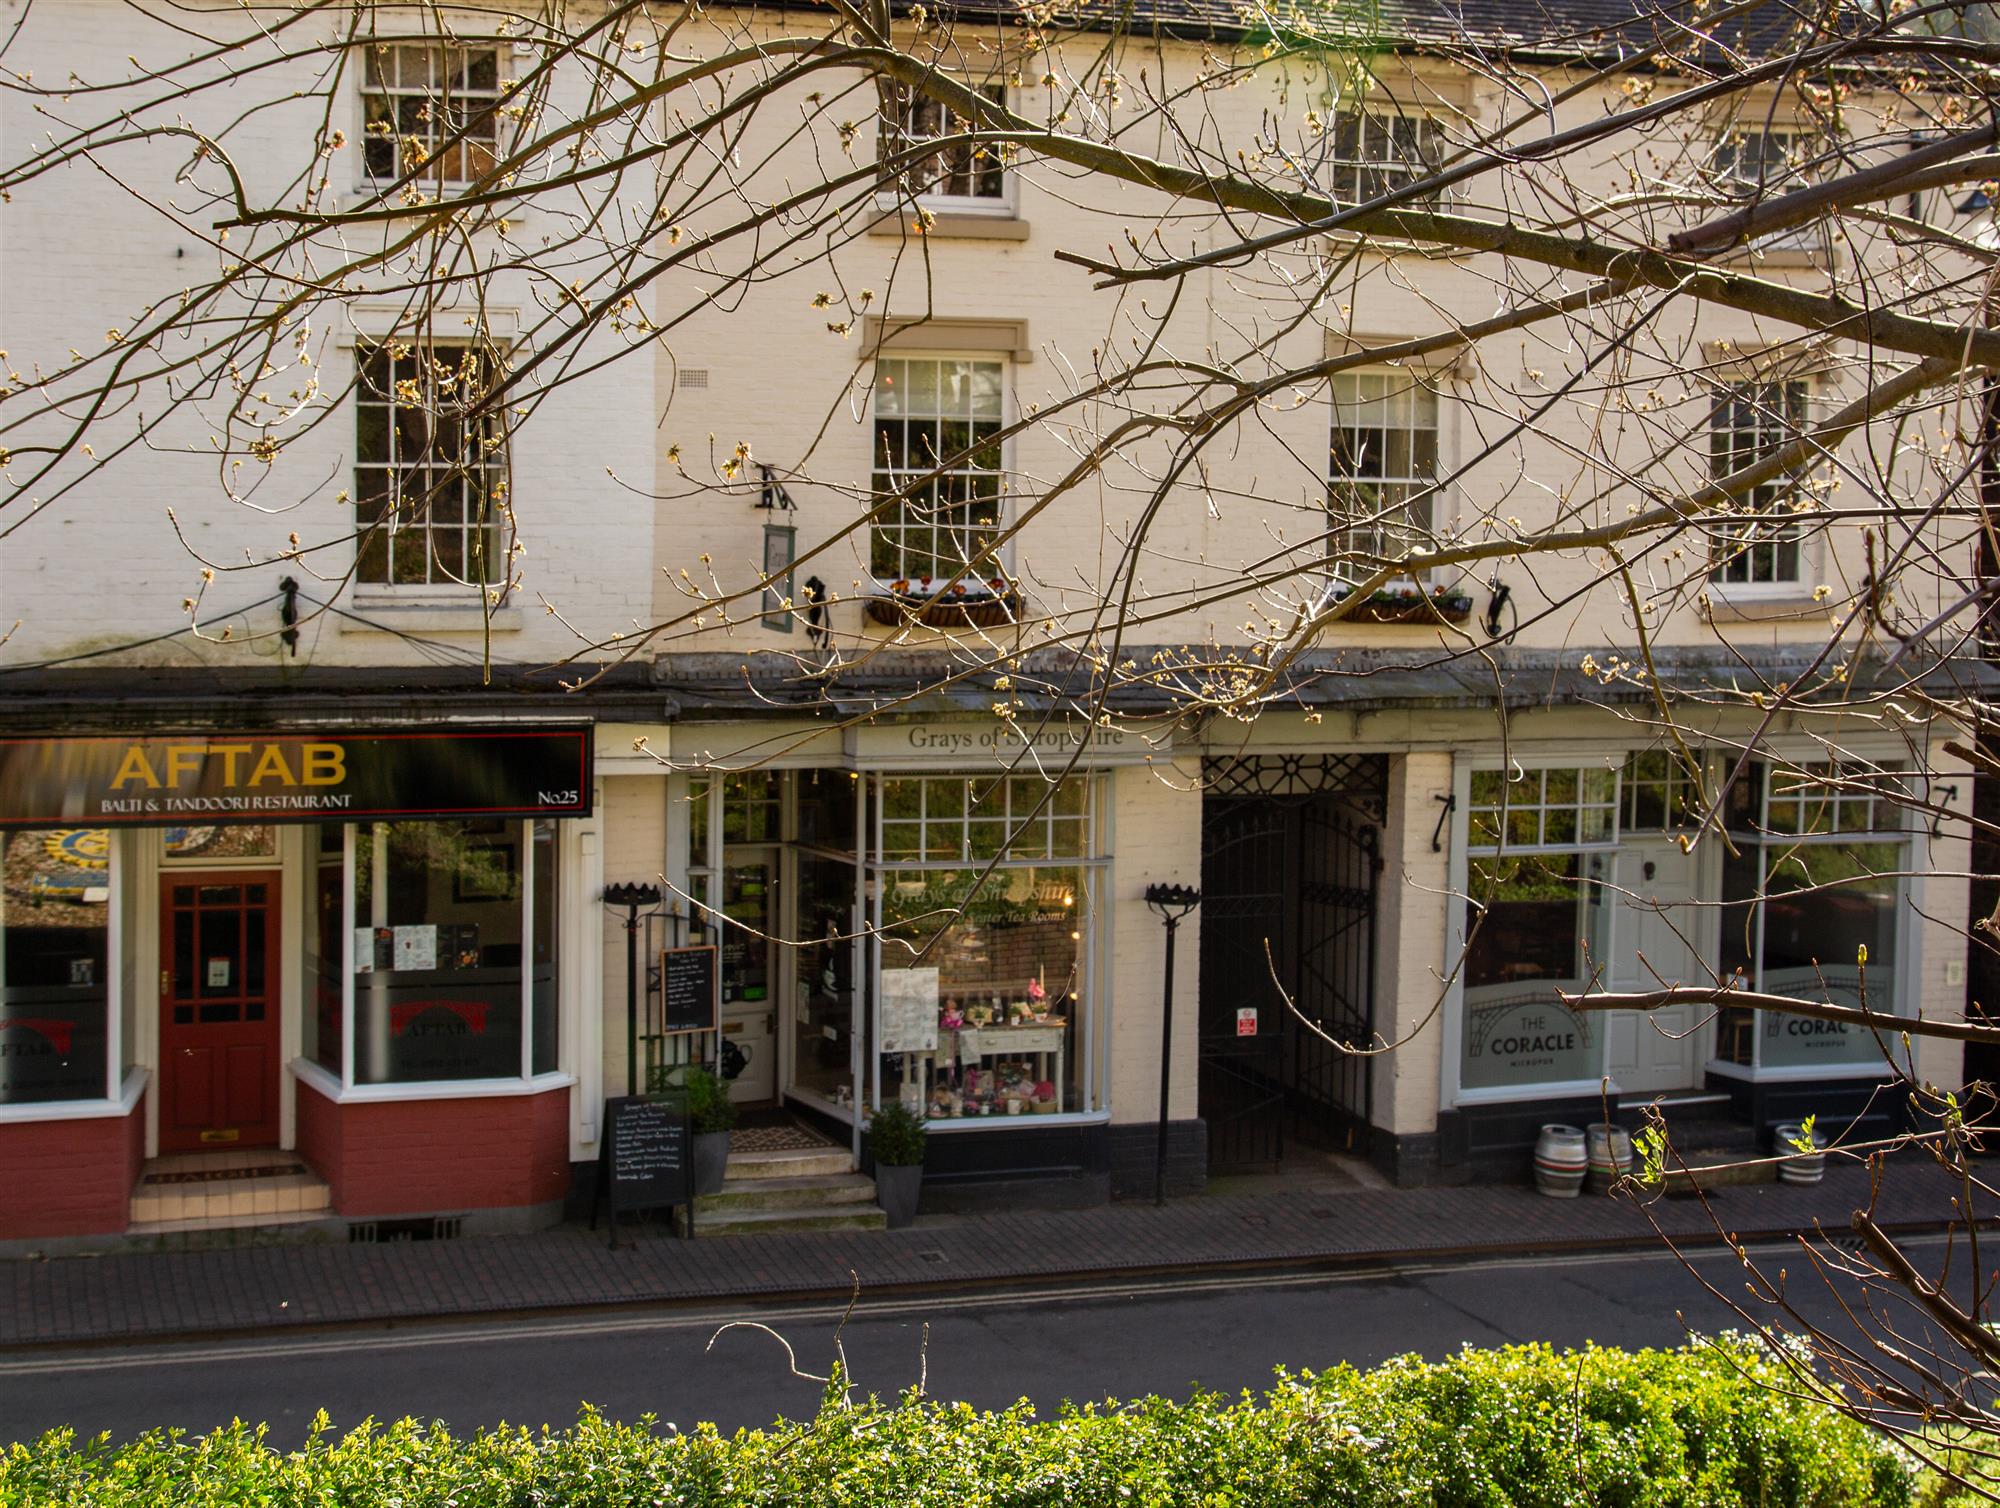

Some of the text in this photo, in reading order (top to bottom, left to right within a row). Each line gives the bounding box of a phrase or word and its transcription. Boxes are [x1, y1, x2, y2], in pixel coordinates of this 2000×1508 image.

[909, 726, 972, 753] Grays
[980, 727, 1002, 748] of
[109, 743, 347, 790] AFTAB
[101, 794, 352, 813] BALTI & TANDOORI RESTAURANT
[979, 879, 1076, 906] Shrshire
[1005, 911, 1025, 922] Tea
[1029, 910, 1066, 923] Rooms
[1521, 1016, 1546, 1030] THE
[1787, 1019, 1866, 1037] CORAC
[1491, 1033, 1575, 1056] CORACLE
